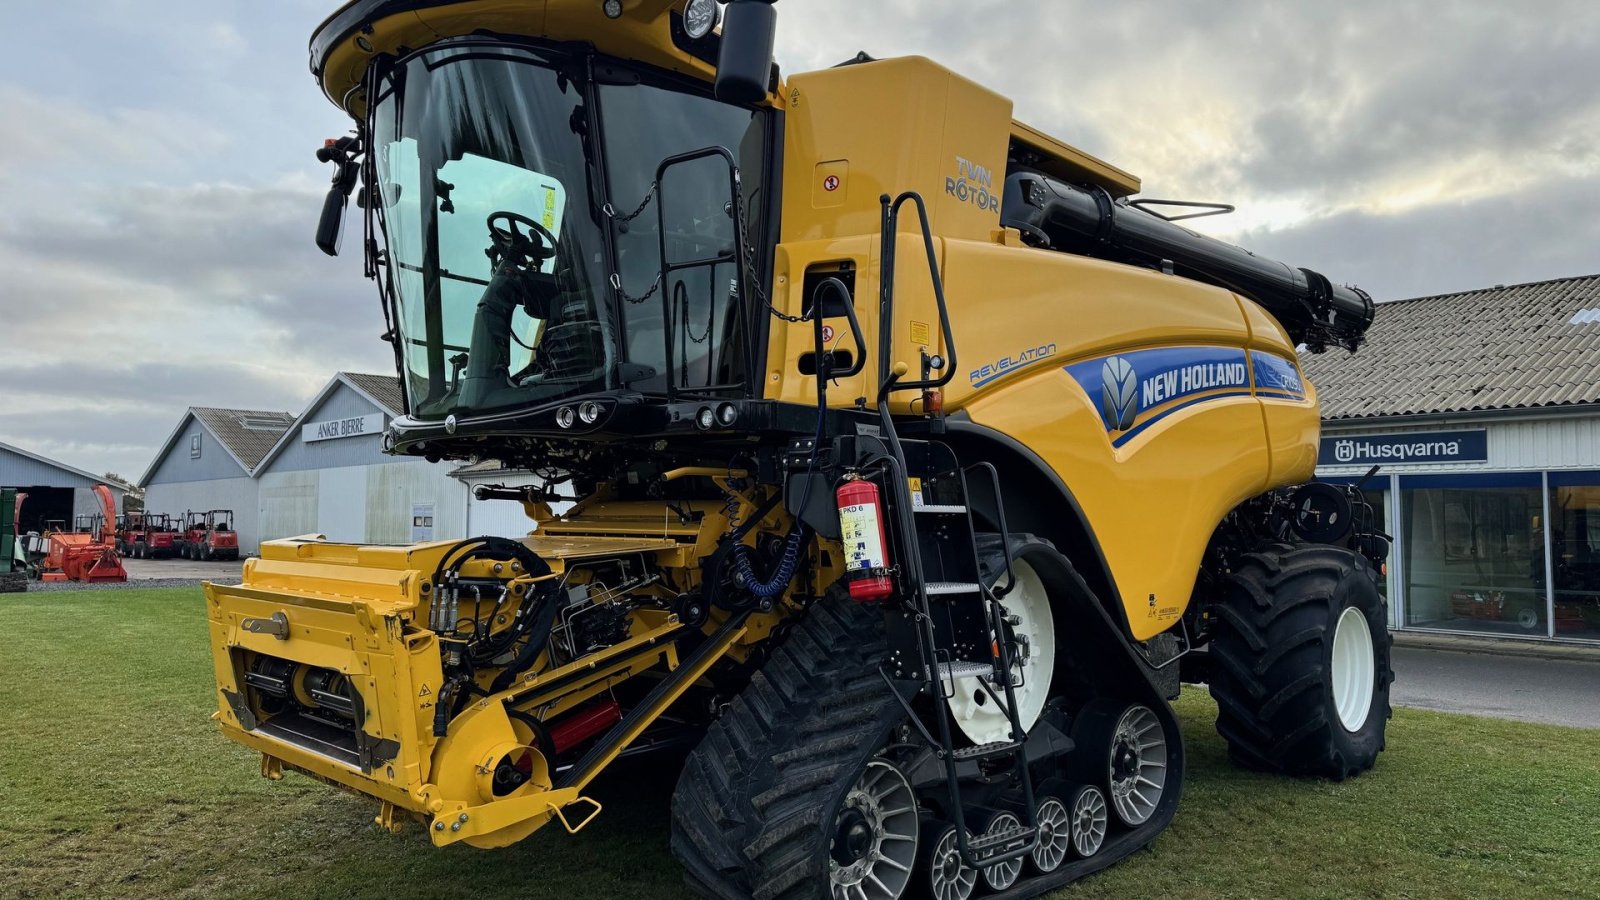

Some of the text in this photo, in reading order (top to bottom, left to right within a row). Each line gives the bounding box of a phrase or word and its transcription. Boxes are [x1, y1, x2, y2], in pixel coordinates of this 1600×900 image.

[956, 156, 991, 188] TWIN
[945, 176, 998, 214] ROTOR
[970, 343, 1056, 382] REVELATION
[1142, 363, 1245, 408] NEW HOLLAND
[317, 421, 339, 438] ANKER
[1356, 441, 1459, 459] Husqvarna
[843, 506, 857, 514] PKD
